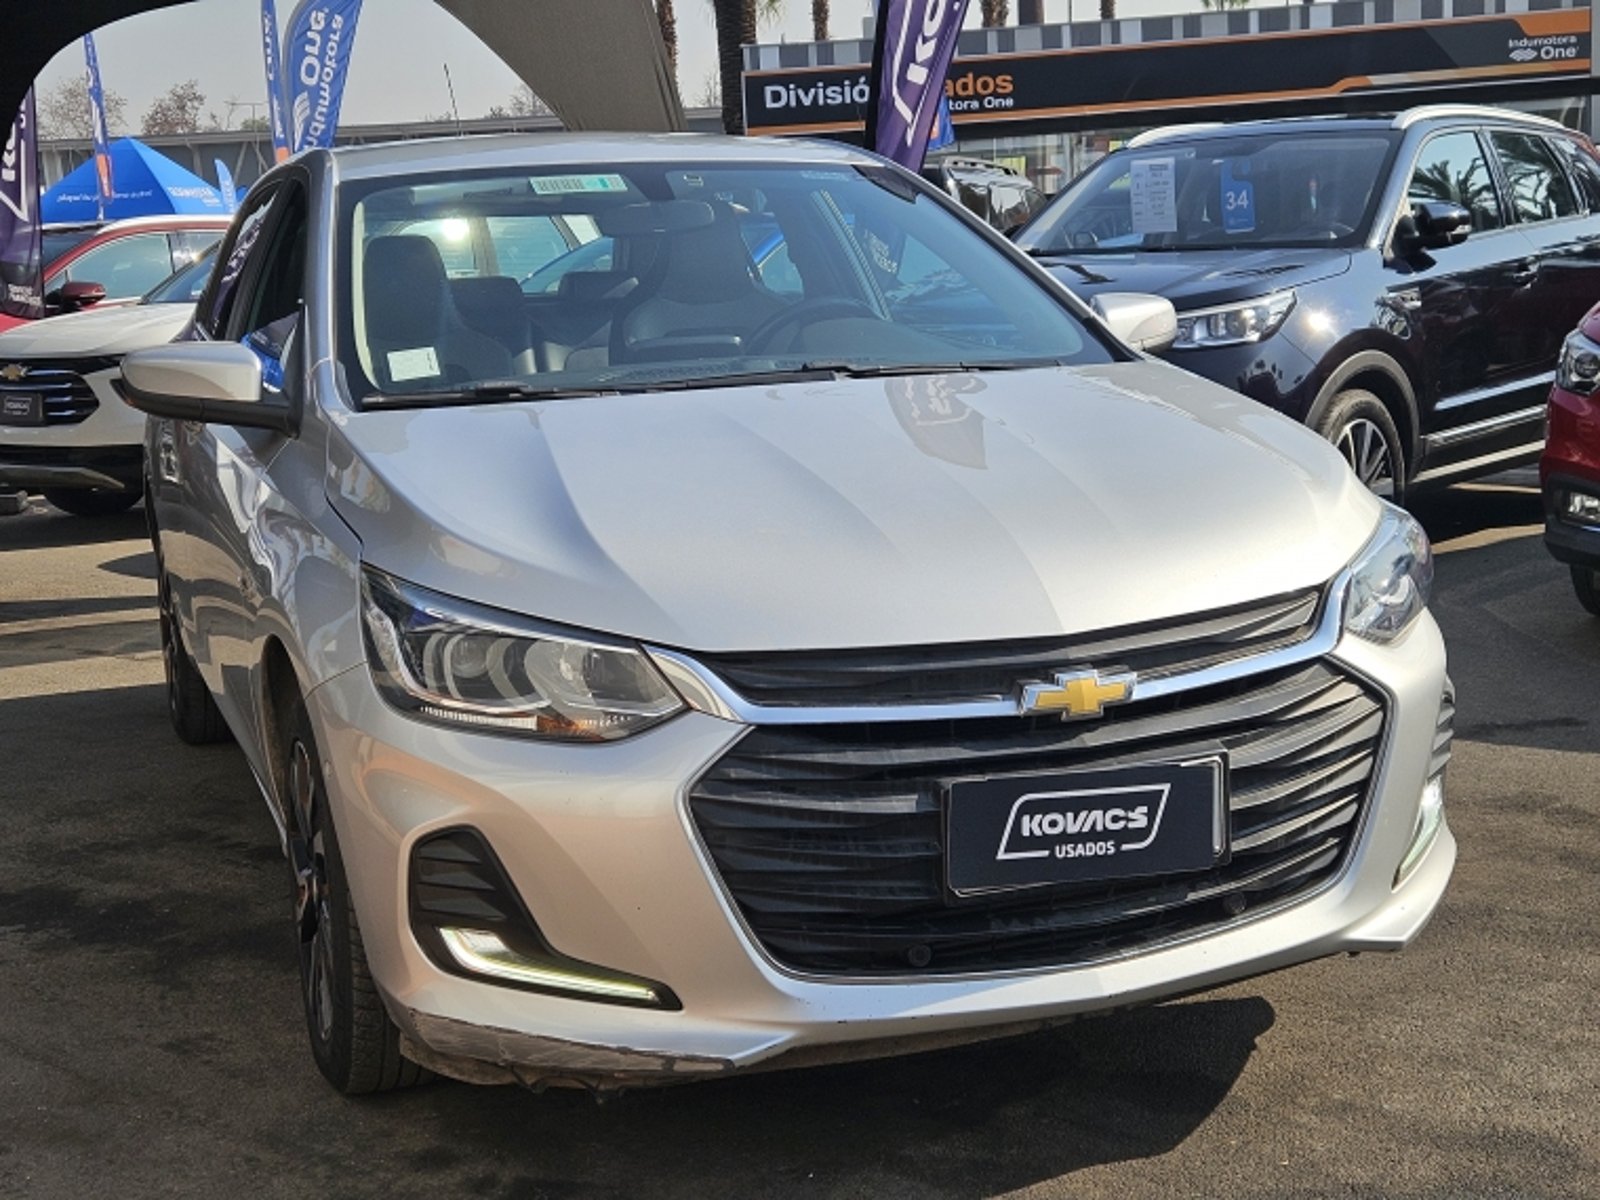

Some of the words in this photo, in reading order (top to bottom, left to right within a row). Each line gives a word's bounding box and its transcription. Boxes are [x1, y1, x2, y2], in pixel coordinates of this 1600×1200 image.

[1508, 35, 1578, 49] Indumotora
[1540, 45, 1577, 60] One
[763, 75, 871, 109] Divisió
[944, 71, 1014, 97] ados
[983, 96, 1014, 109] One
[1225, 189, 1249, 211] 34
[1020, 805, 1149, 837] KOVACS
[1054, 840, 1116, 859] USADOS
